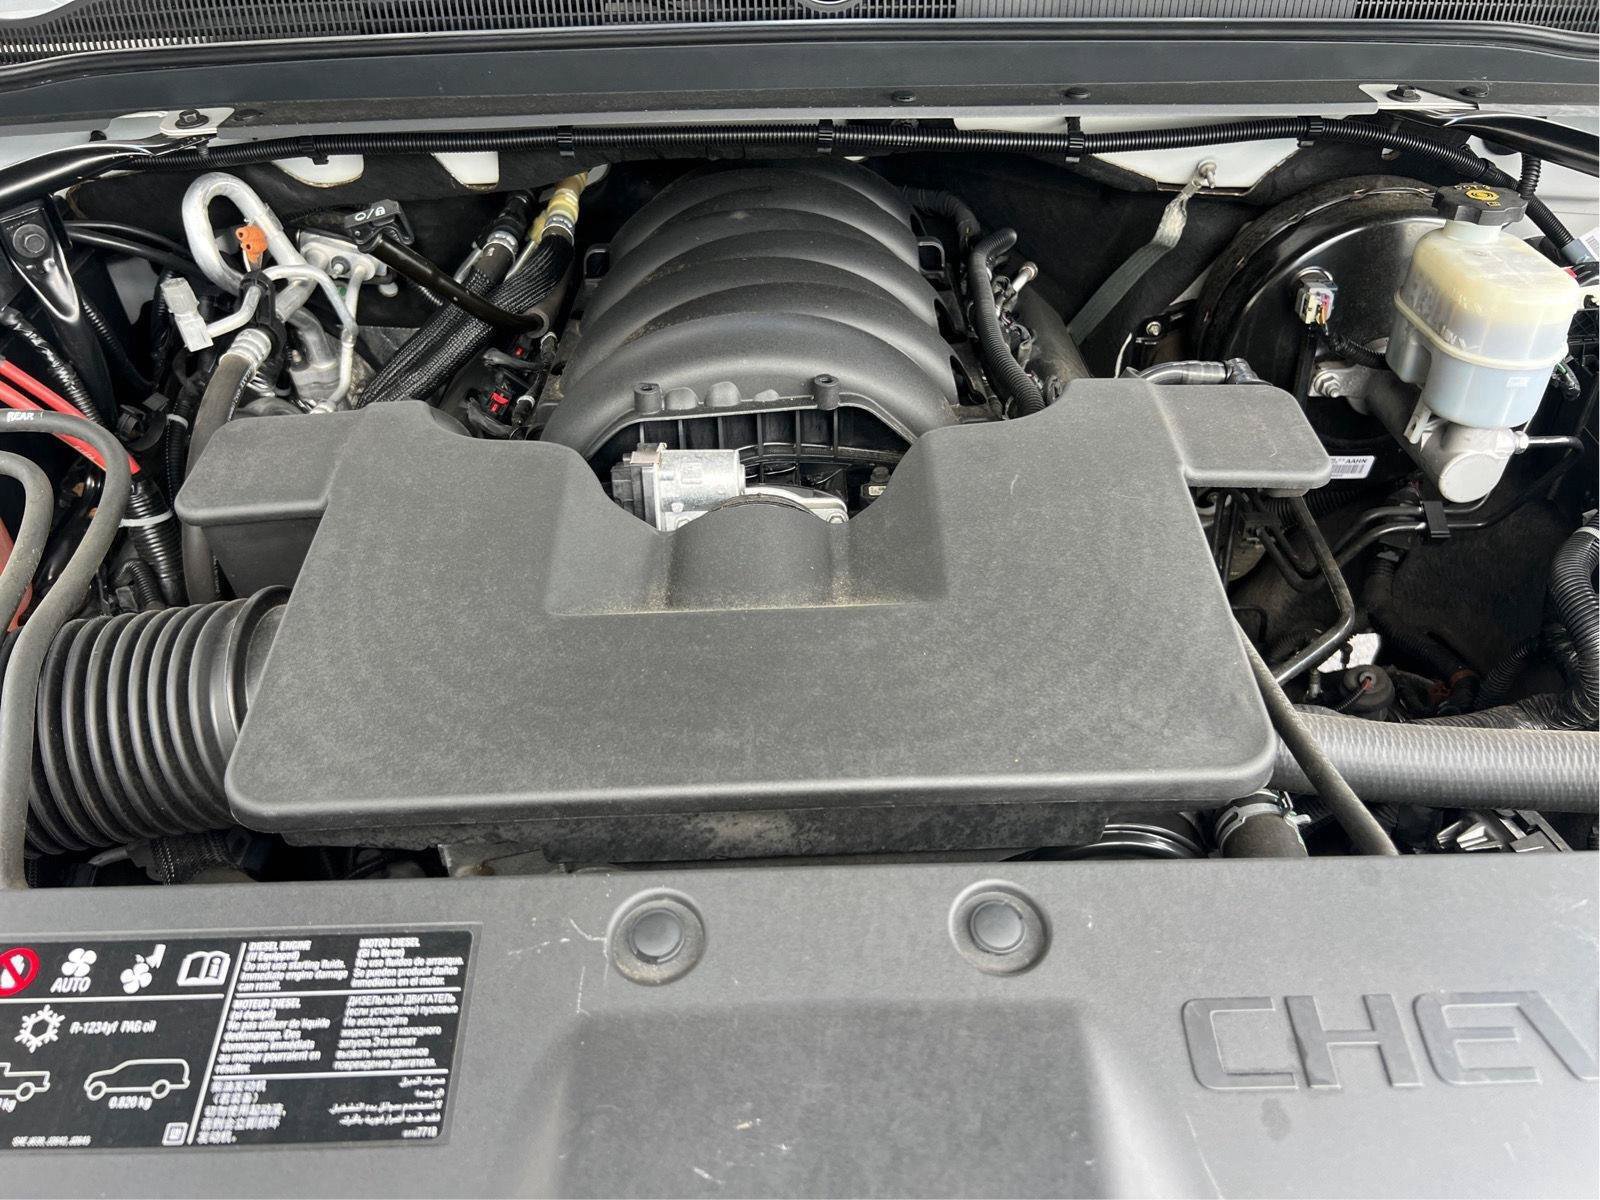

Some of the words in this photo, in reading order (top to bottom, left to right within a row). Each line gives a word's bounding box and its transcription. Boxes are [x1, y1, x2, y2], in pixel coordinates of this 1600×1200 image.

[7, 411, 35, 422] REAR
[248, 941, 278, 951] DIESEL
[279, 940, 312, 950] ENGINE
[359, 938, 390, 948] MOTOR
[390, 937, 420, 947] DIESEL
[257, 950, 300, 961] Equipped)
[242, 961, 256, 972] Do
[257, 961, 271, 970] not
[271, 961, 288, 970] use
[288, 960, 320, 971] starting
[320, 959, 346, 970] fluids.
[355, 958, 368, 968] No
[368, 959, 384, 968] use
[384, 958, 412, 967] fluidos
[413, 957, 425, 966] de
[240, 971, 285, 982] Immediate
[285, 970, 314, 982] engine
[314, 969, 348, 980] damage
[353, 967, 365, 978] Se
[365, 968, 397, 978] pueden
[397, 967, 431, 978] producir
[432, 966, 459, 976] daños
[50, 976, 91, 993] AUTO
[236, 981, 254, 991] can
[255, 980, 281, 991] result.
[397, 978, 409, 987] en
[410, 977, 418, 986] el
[419, 977, 445, 986] motor.
[232, 998, 271, 1010] MOTEUR
[270, 997, 301, 1009] DIESEL
[346, 993, 404, 1007] ДИЗЕЛЬНЫЙ
[404, 992, 457, 1006] ДВИГАТЕЛЬ
[226, 1020, 241, 1031] Ne
[241, 1020, 258, 1031] pas
[287, 1018, 300, 1029] de
[300, 1017, 331, 1030] liquide
[342, 1016, 356, 1027] Не
[69, 1020, 119, 1036] R-1234yf
[282, 1028, 302, 1040] Des
[220, 1041, 270, 1053] dommages
[389, 1037, 417, 1047] может
[217, 1053, 231, 1063] au
[231, 1052, 263, 1063] moteur
[263, 1050, 308, 1064] pourraient
[308, 1050, 321, 1060] en
[138, 1095, 153, 1111] kg
